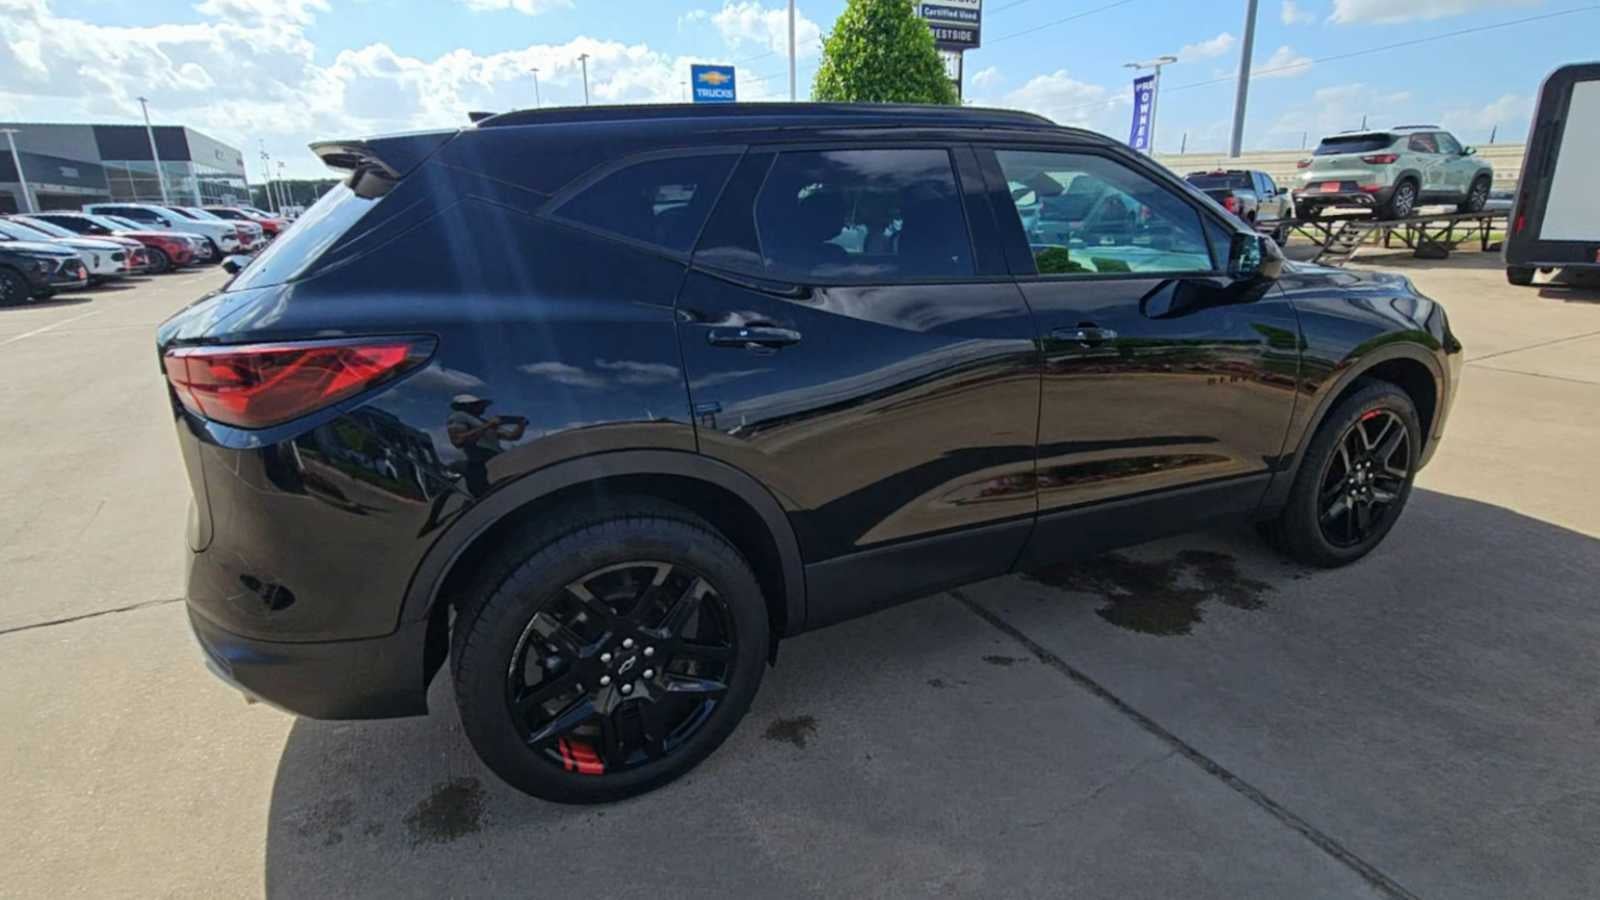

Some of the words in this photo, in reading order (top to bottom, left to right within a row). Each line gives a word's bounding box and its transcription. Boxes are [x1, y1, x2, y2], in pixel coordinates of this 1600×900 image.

[924, 7, 957, 17] Certified
[960, 11, 977, 20] Used
[696, 88, 733, 99] TRUCKS
